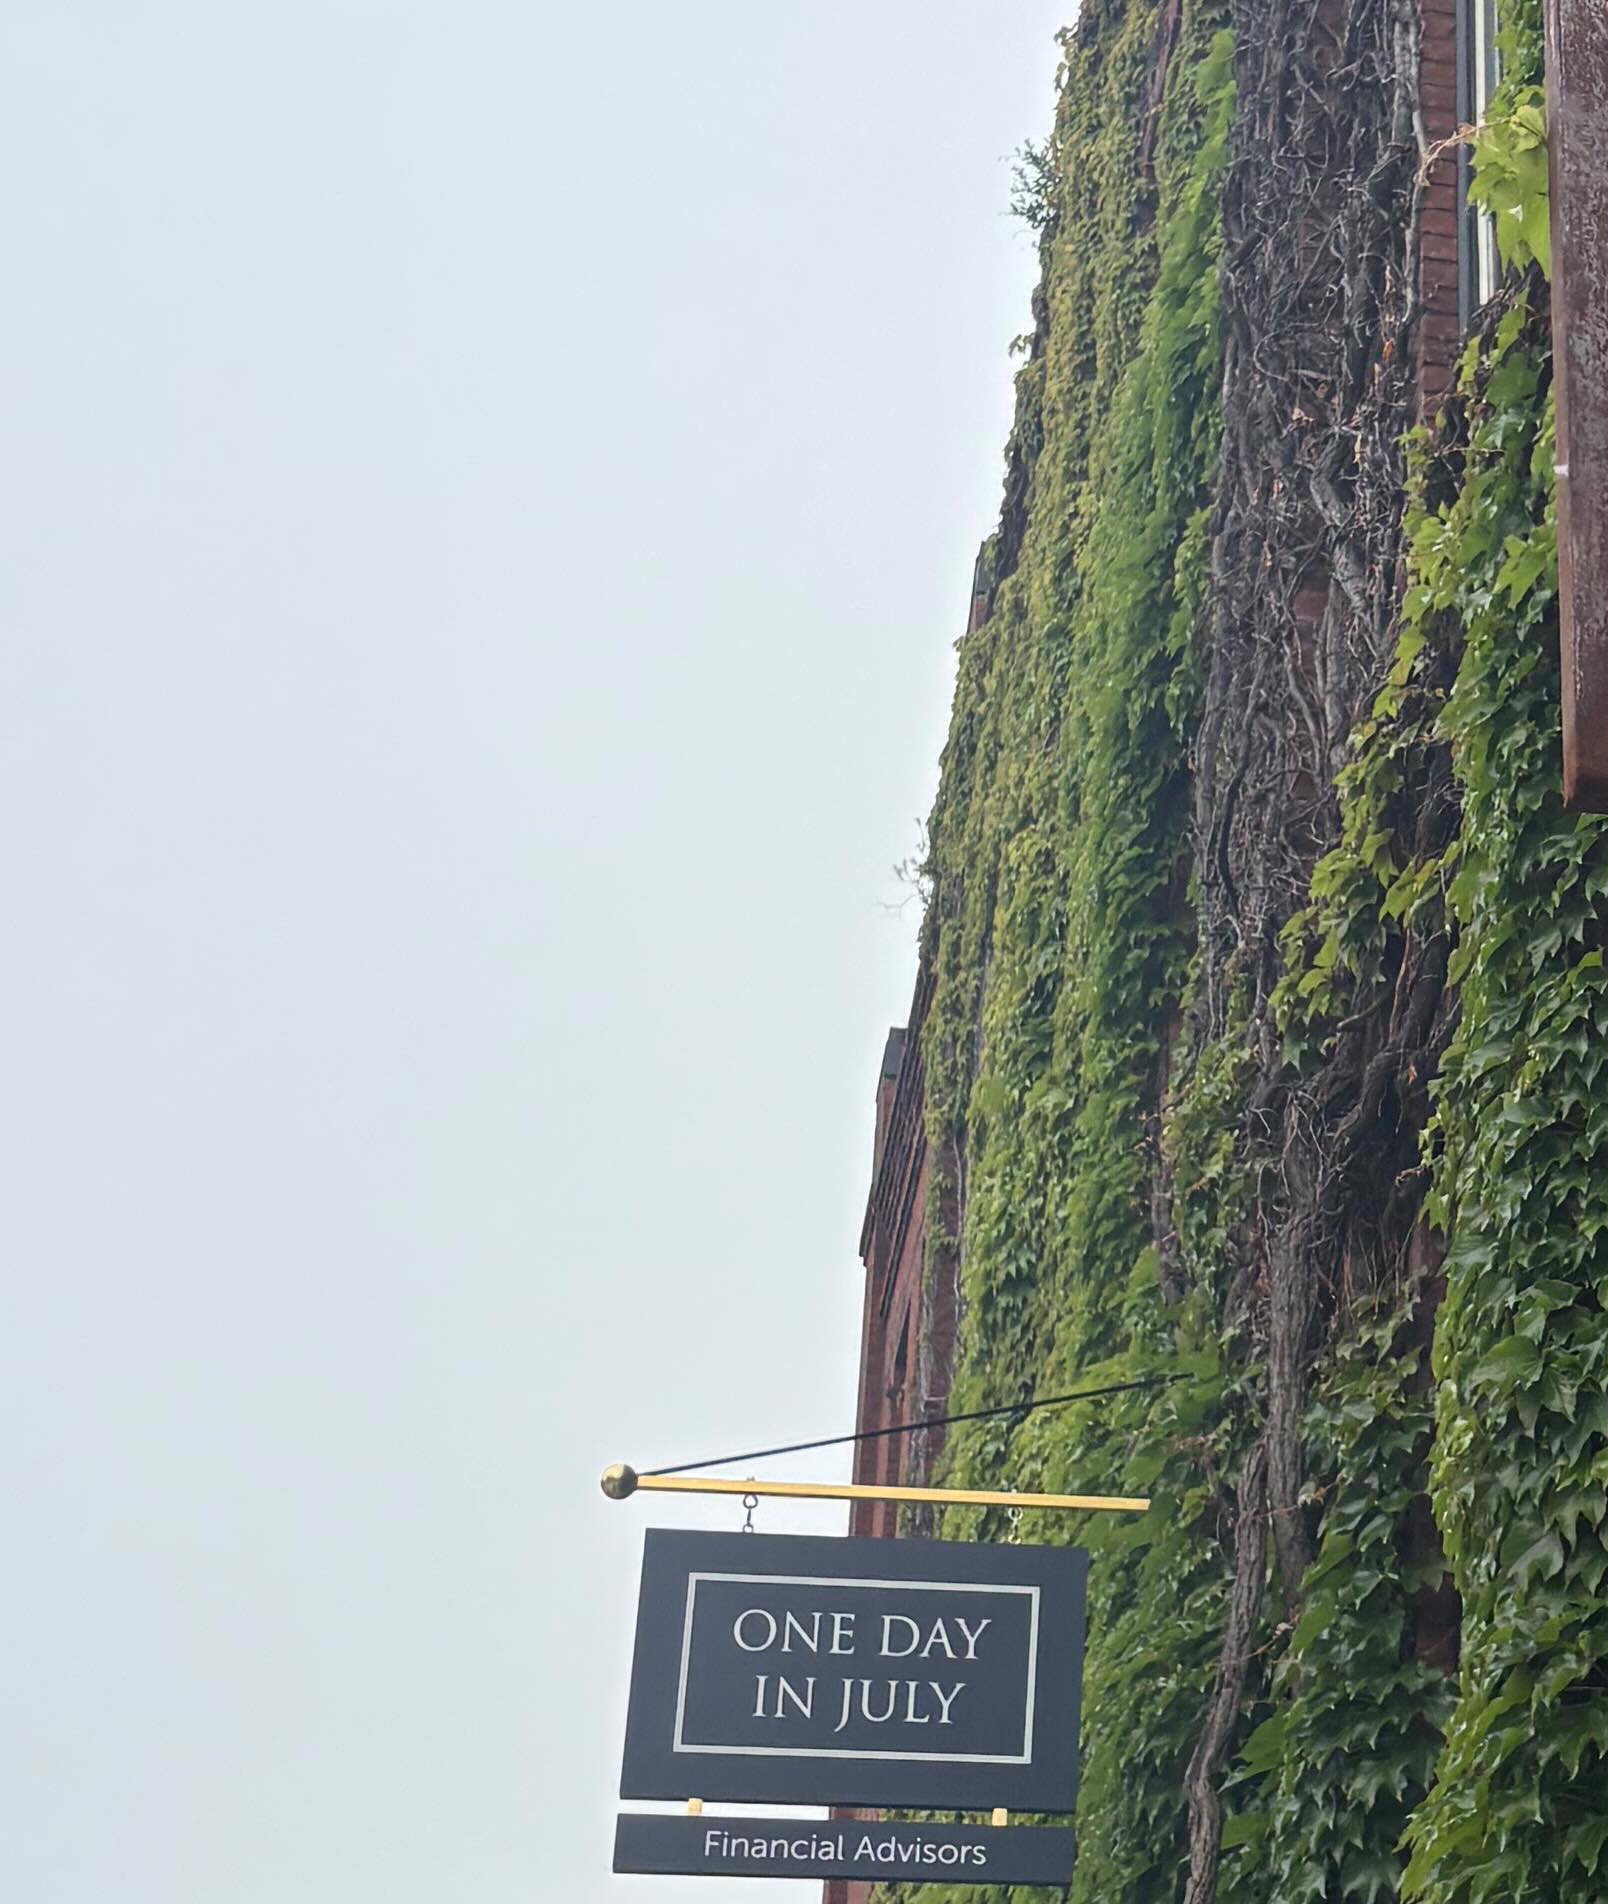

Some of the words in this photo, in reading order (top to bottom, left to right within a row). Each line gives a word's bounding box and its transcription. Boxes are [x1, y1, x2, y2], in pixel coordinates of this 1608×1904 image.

[733, 1609, 855, 1655] ONE
[879, 1614, 991, 1659] DAY
[752, 1675, 816, 1719] IN
[834, 1678, 966, 1732] JULY
[704, 1830, 844, 1861] Financial
[854, 1836, 987, 1865] Advisors
